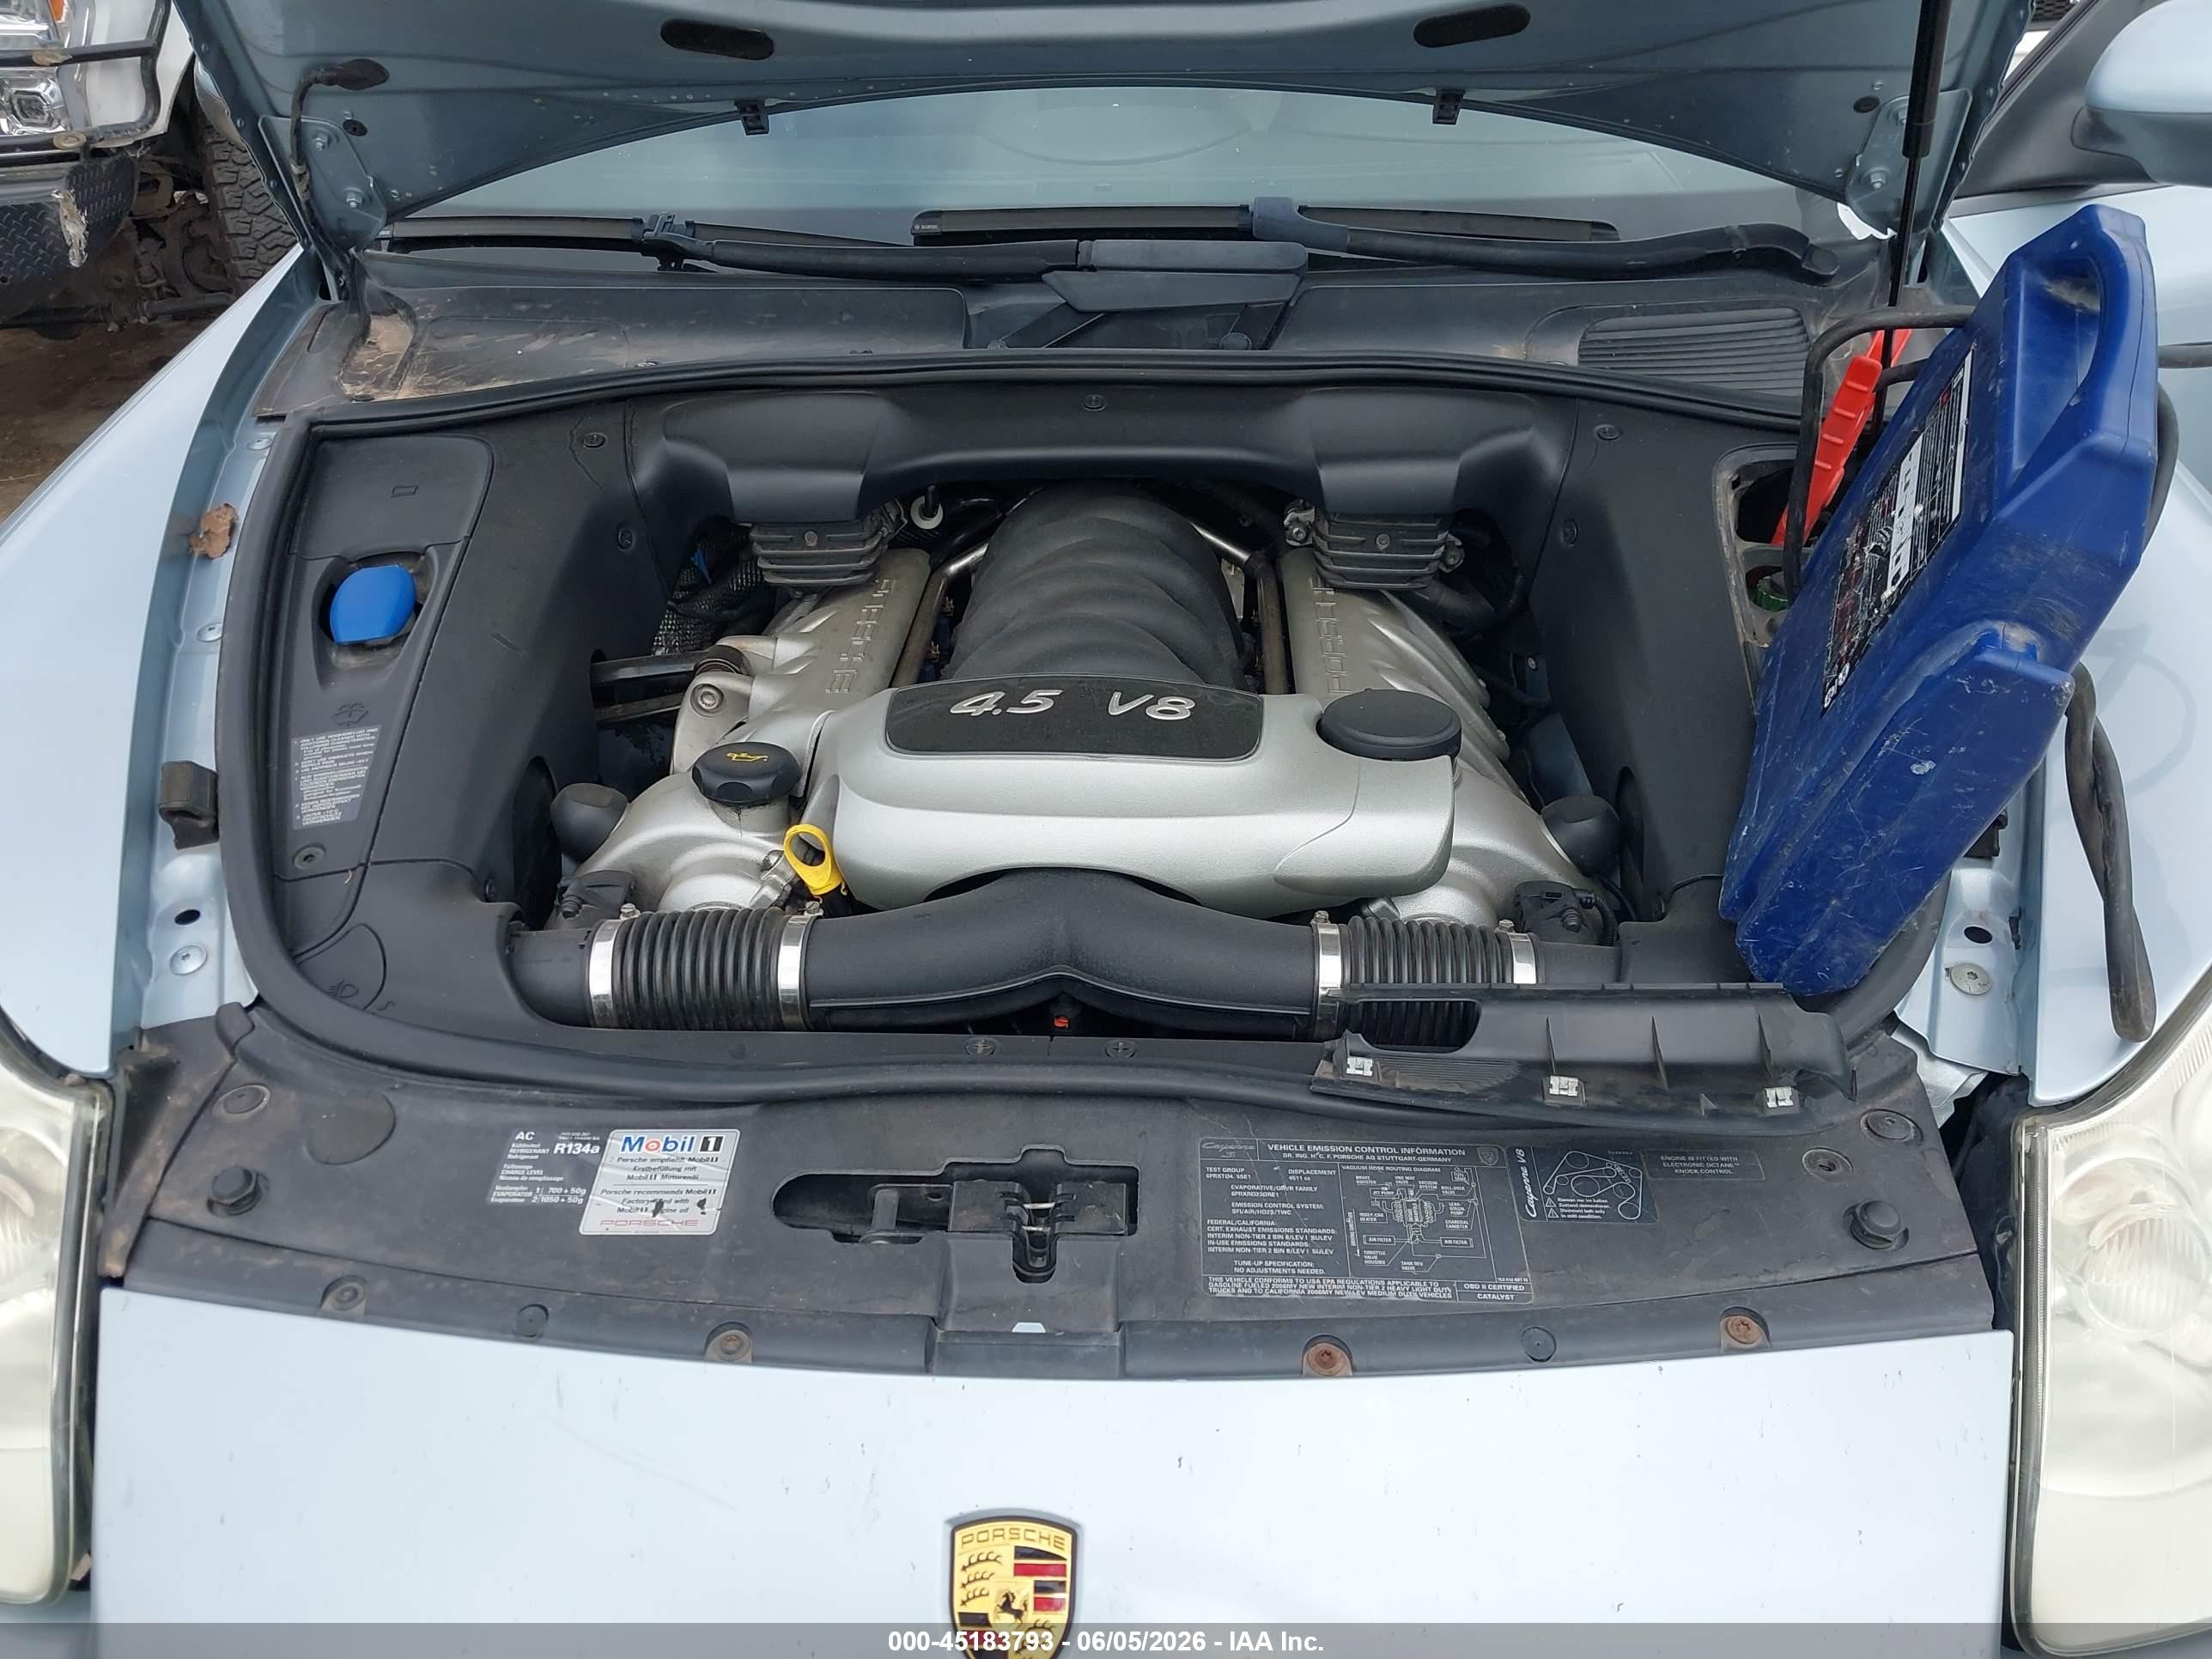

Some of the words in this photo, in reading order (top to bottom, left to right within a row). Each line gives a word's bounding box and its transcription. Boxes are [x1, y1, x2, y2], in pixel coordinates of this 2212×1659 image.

[950, 690, 1064, 717] 4.5
[1107, 691, 1195, 721] V8
[515, 1132, 535, 1140] AC
[553, 1143, 600, 1155] R134a
[620, 1136, 695, 1152] Mobil
[1401, 1147, 1466, 1155] INFORMATION
[1515, 1149, 1527, 1163] V8
[570, 1188, 587, 1196] 50g
[1520, 1164, 1540, 1218] Cayenne
[961, 1527, 1065, 1551] PORSCHE
